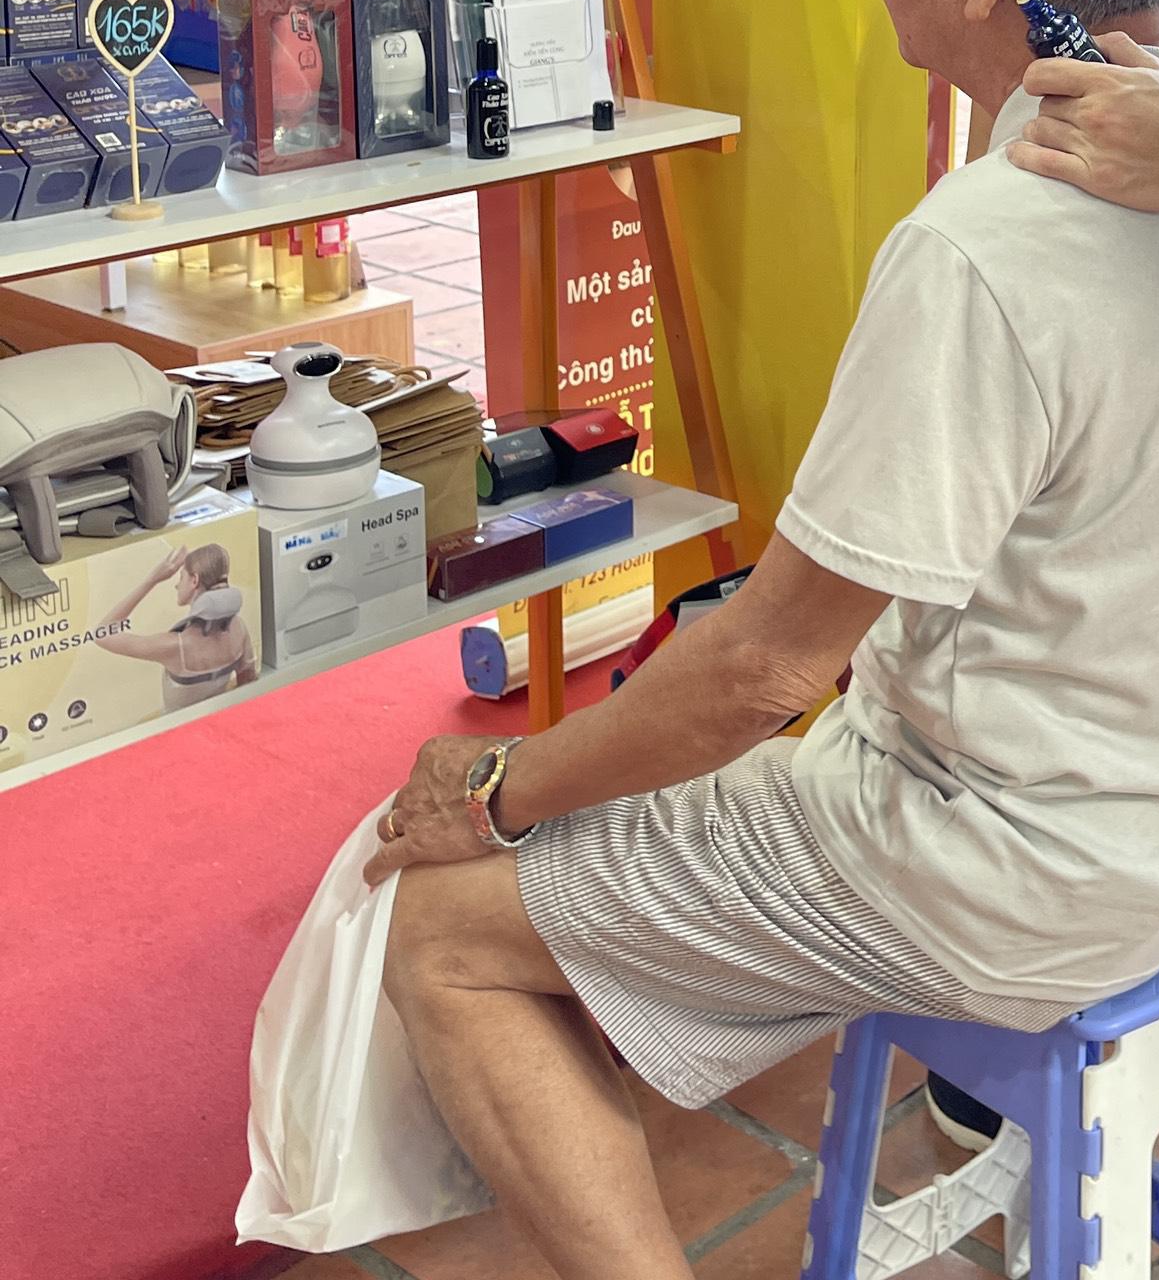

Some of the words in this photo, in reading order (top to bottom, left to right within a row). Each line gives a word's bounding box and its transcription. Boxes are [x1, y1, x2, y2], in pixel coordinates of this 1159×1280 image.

[98, 6, 166, 43] 165K
[66, 90, 86, 100] CAO
[90, 86, 111, 96] XOA
[612, 220, 641, 240] Đau
[566, 272, 611, 304] Một
[361, 511, 392, 533] Head
[396, 506, 419, 522] Spa
[30, 618, 132, 661] MASSAGER
